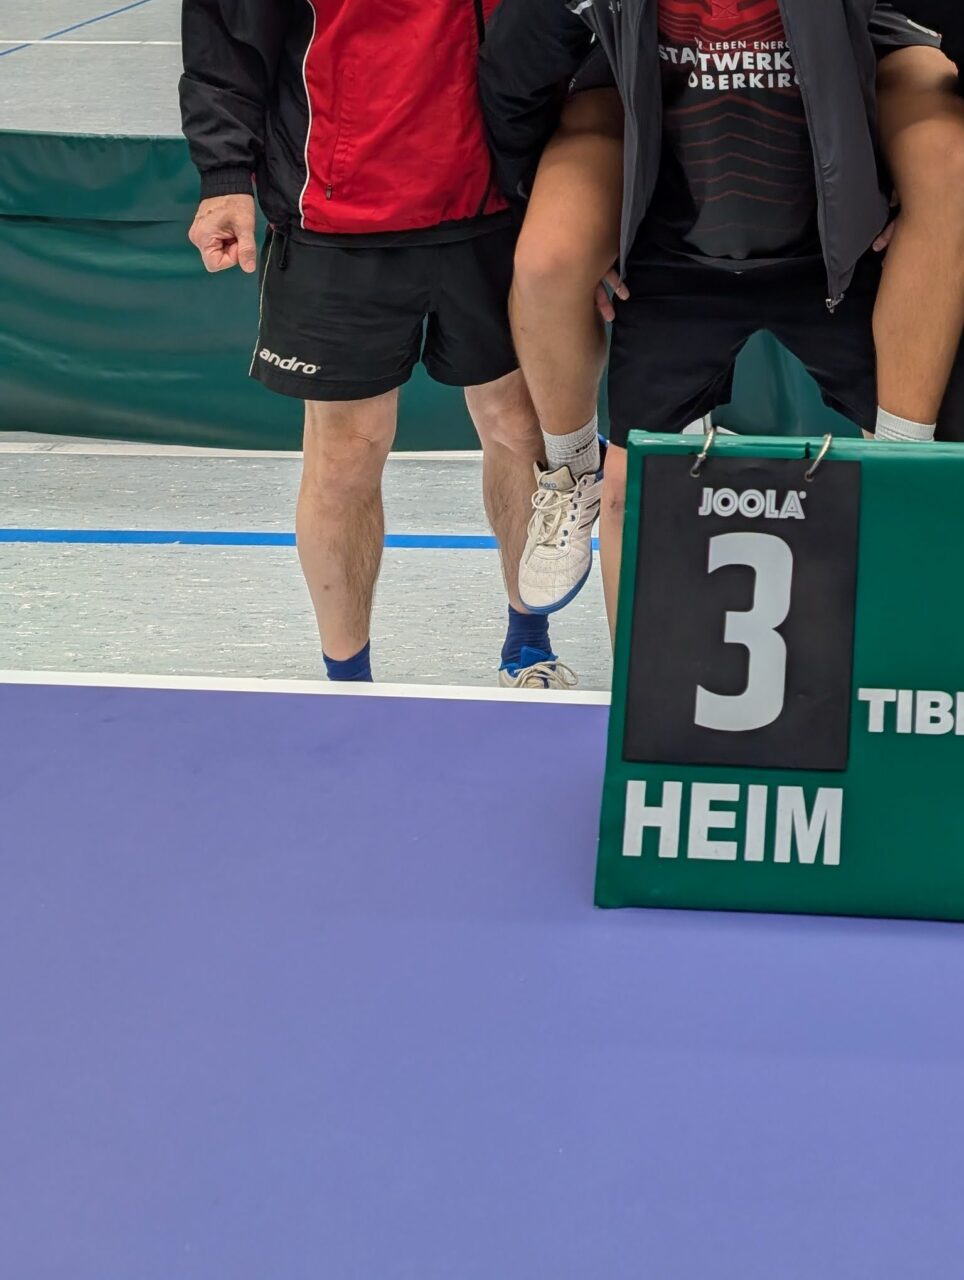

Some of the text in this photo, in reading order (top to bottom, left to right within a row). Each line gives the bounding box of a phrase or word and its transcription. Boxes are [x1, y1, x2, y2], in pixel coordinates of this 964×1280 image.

[709, 40, 747, 51] LEBEN
[688, 71, 800, 91] OBERKIR
[259, 348, 317, 375] andro
[698, 487, 804, 520] JOOLA
[693, 531, 794, 733] 3
[622, 780, 844, 866] HEIM
